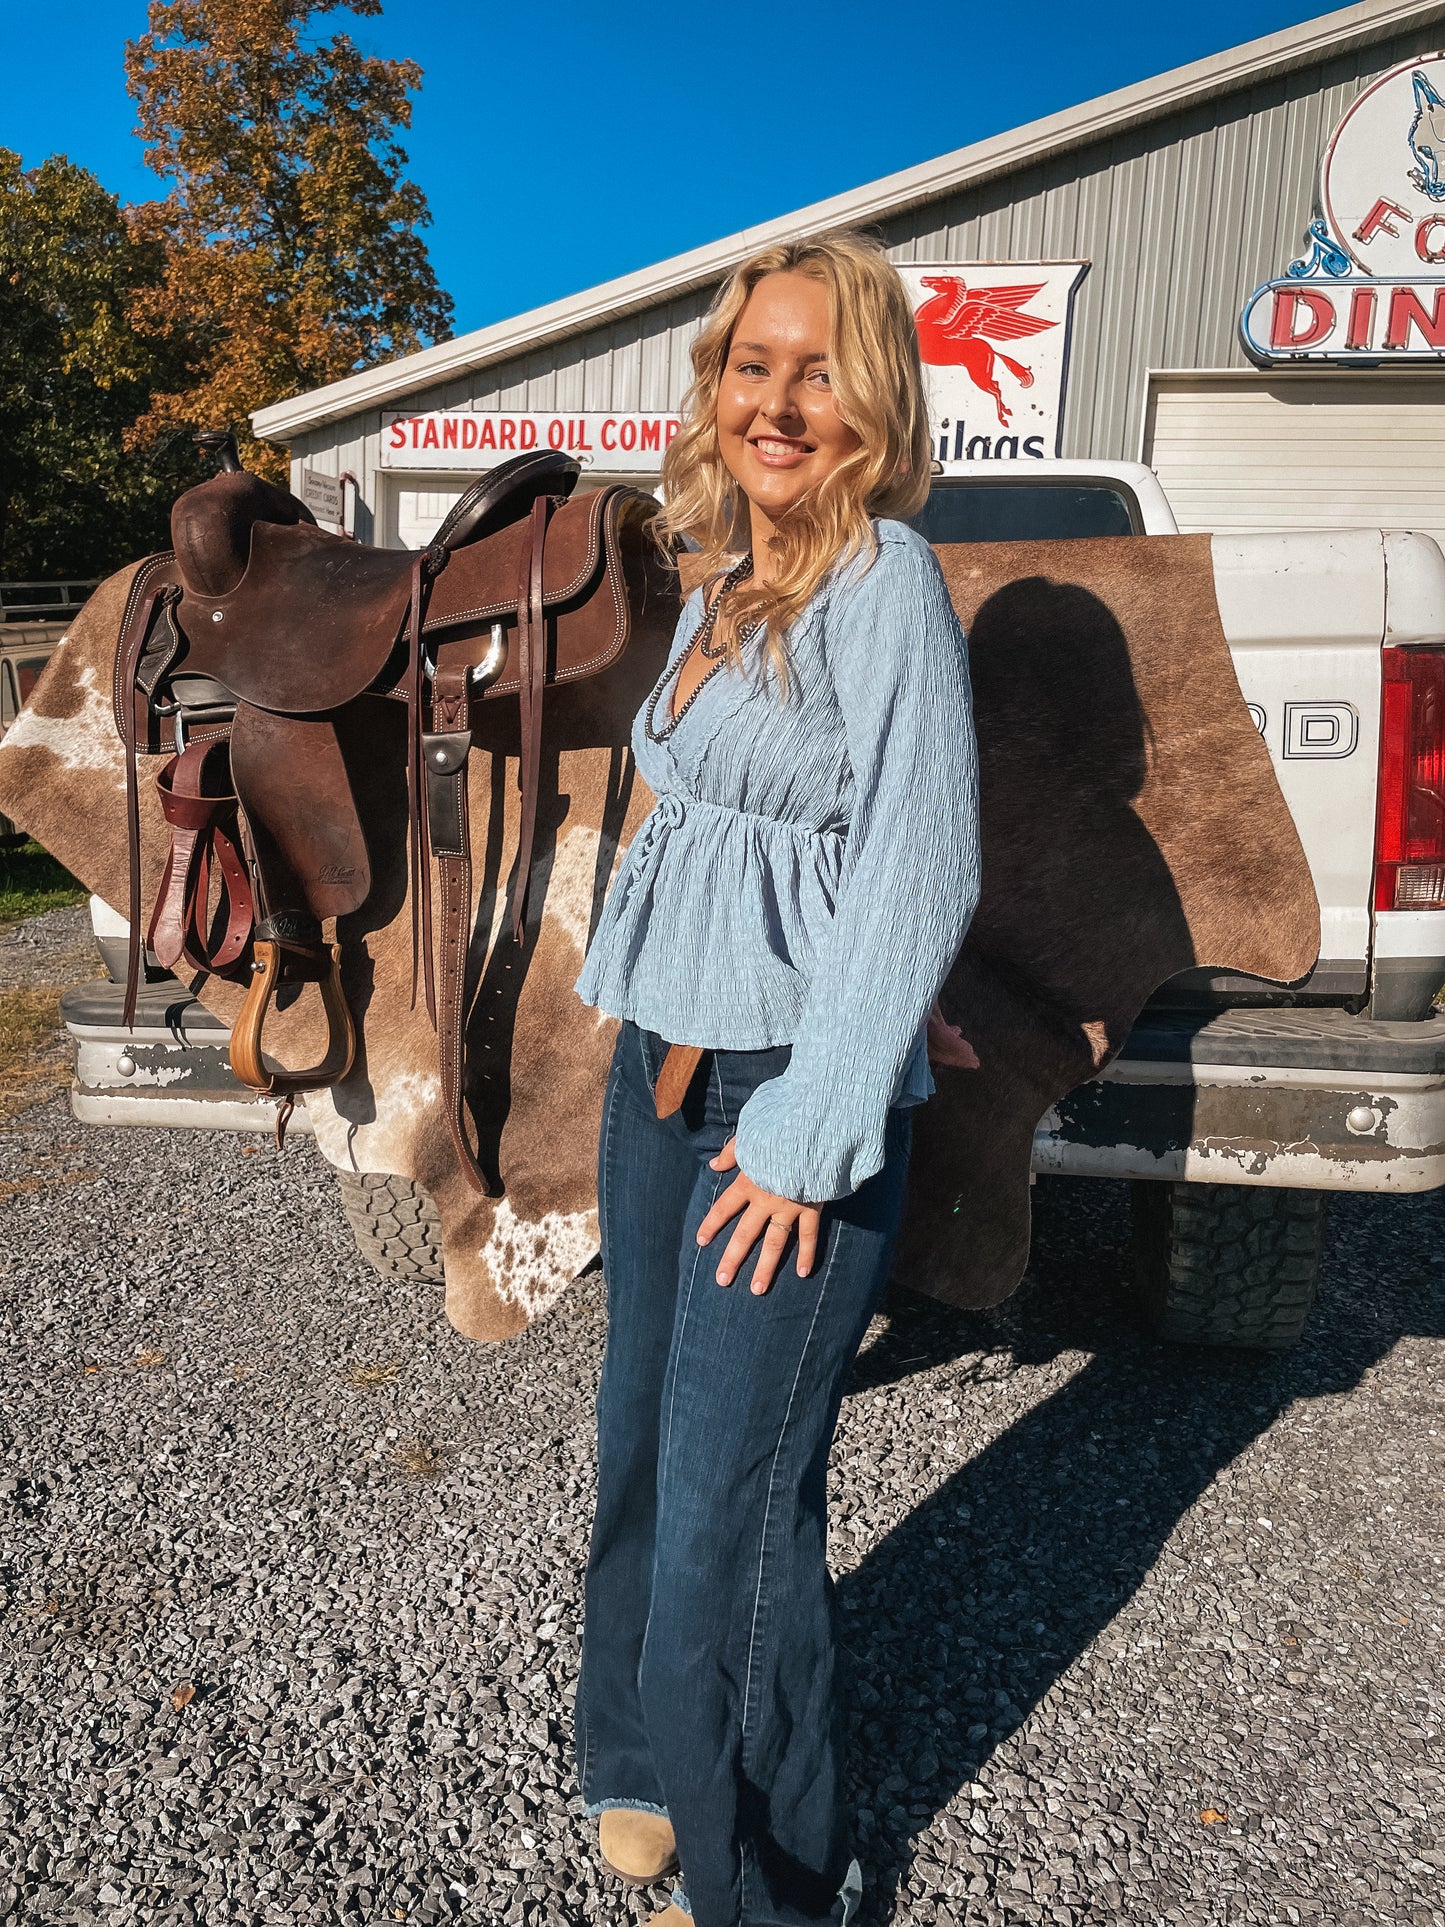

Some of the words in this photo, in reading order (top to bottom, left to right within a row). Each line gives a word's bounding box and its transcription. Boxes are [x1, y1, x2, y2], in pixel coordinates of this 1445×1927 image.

[1269, 286, 1445, 351] DIN
[389, 416, 537, 450] STANDARD
[547, 418, 592, 451] OIL
[931, 419, 1045, 460] ilgas
